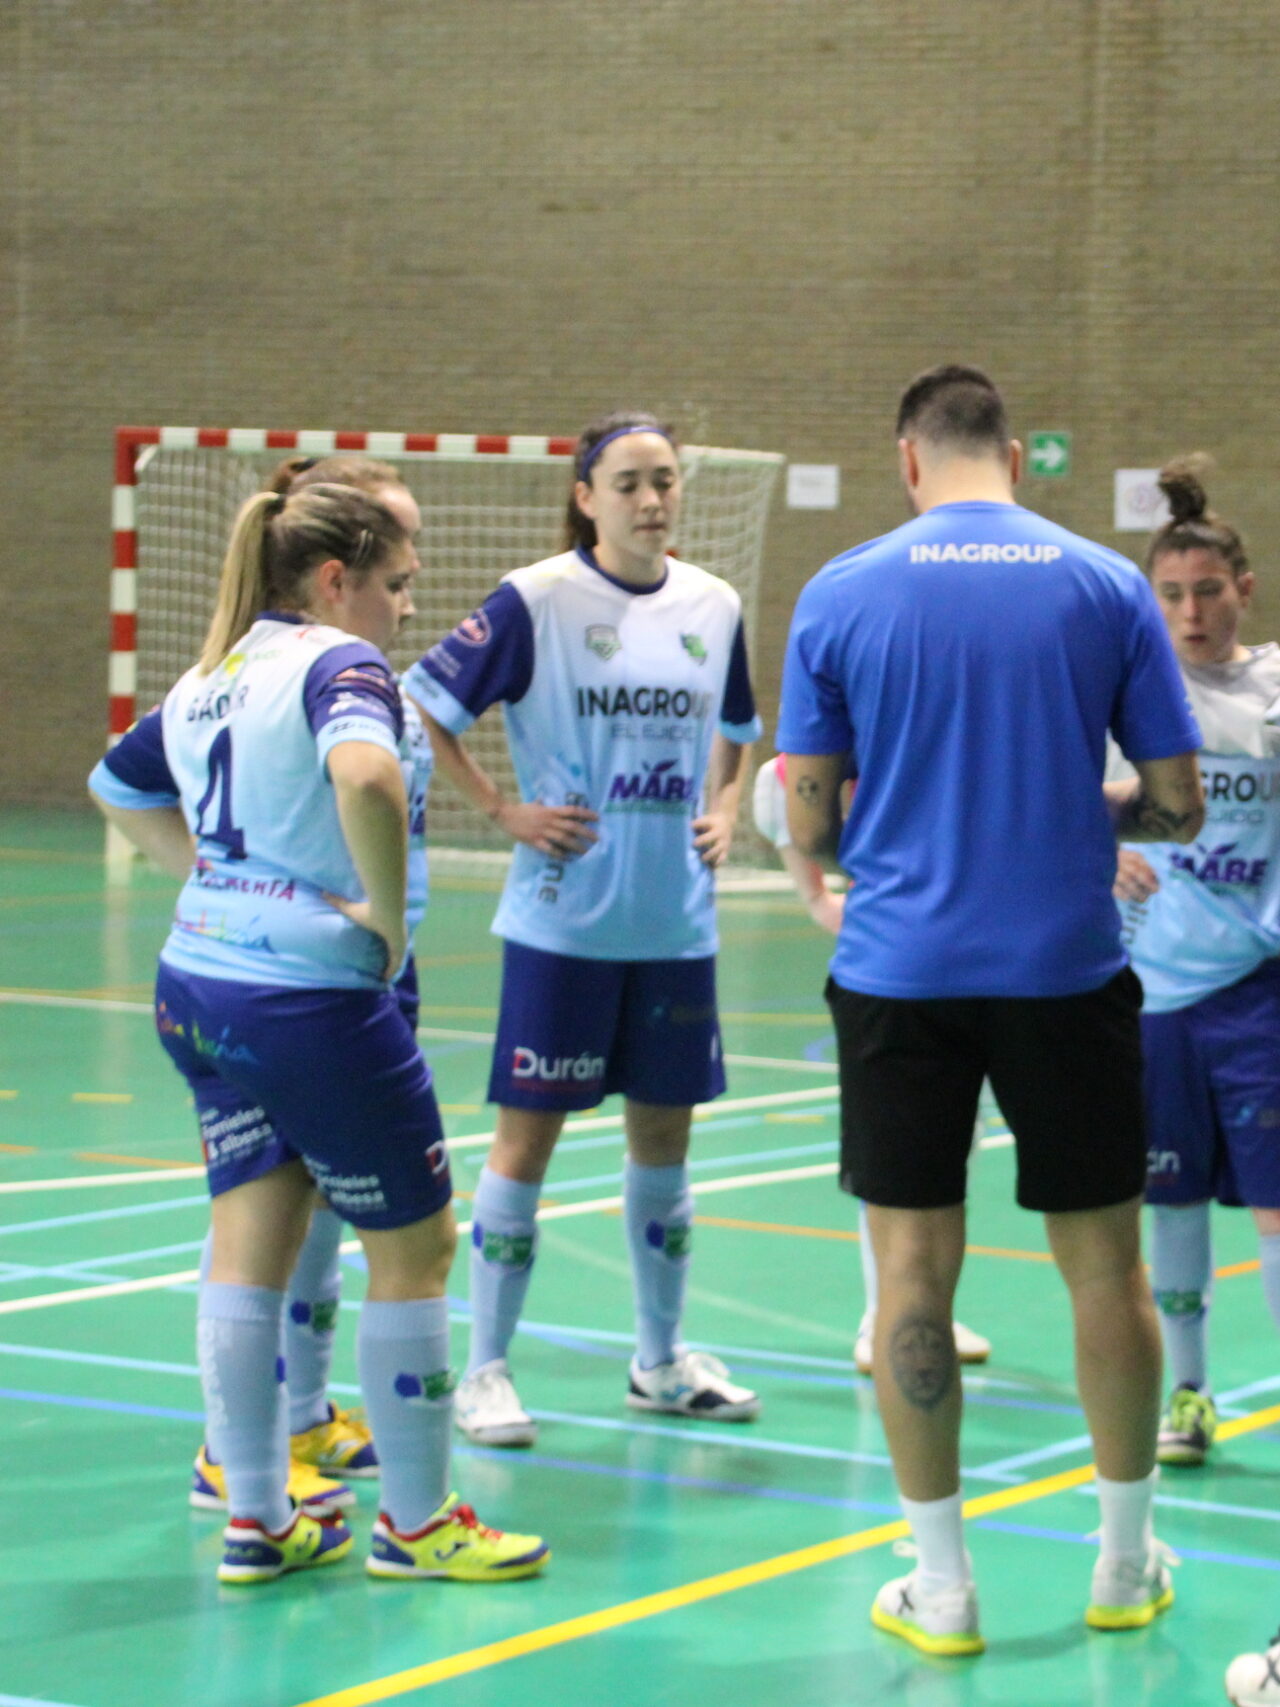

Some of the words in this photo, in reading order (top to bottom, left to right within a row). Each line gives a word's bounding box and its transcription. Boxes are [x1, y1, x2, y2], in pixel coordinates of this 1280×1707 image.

[910, 543, 1062, 563] INAGROUP
[196, 725, 248, 860] 1
[513, 1046, 605, 1081] Durán
